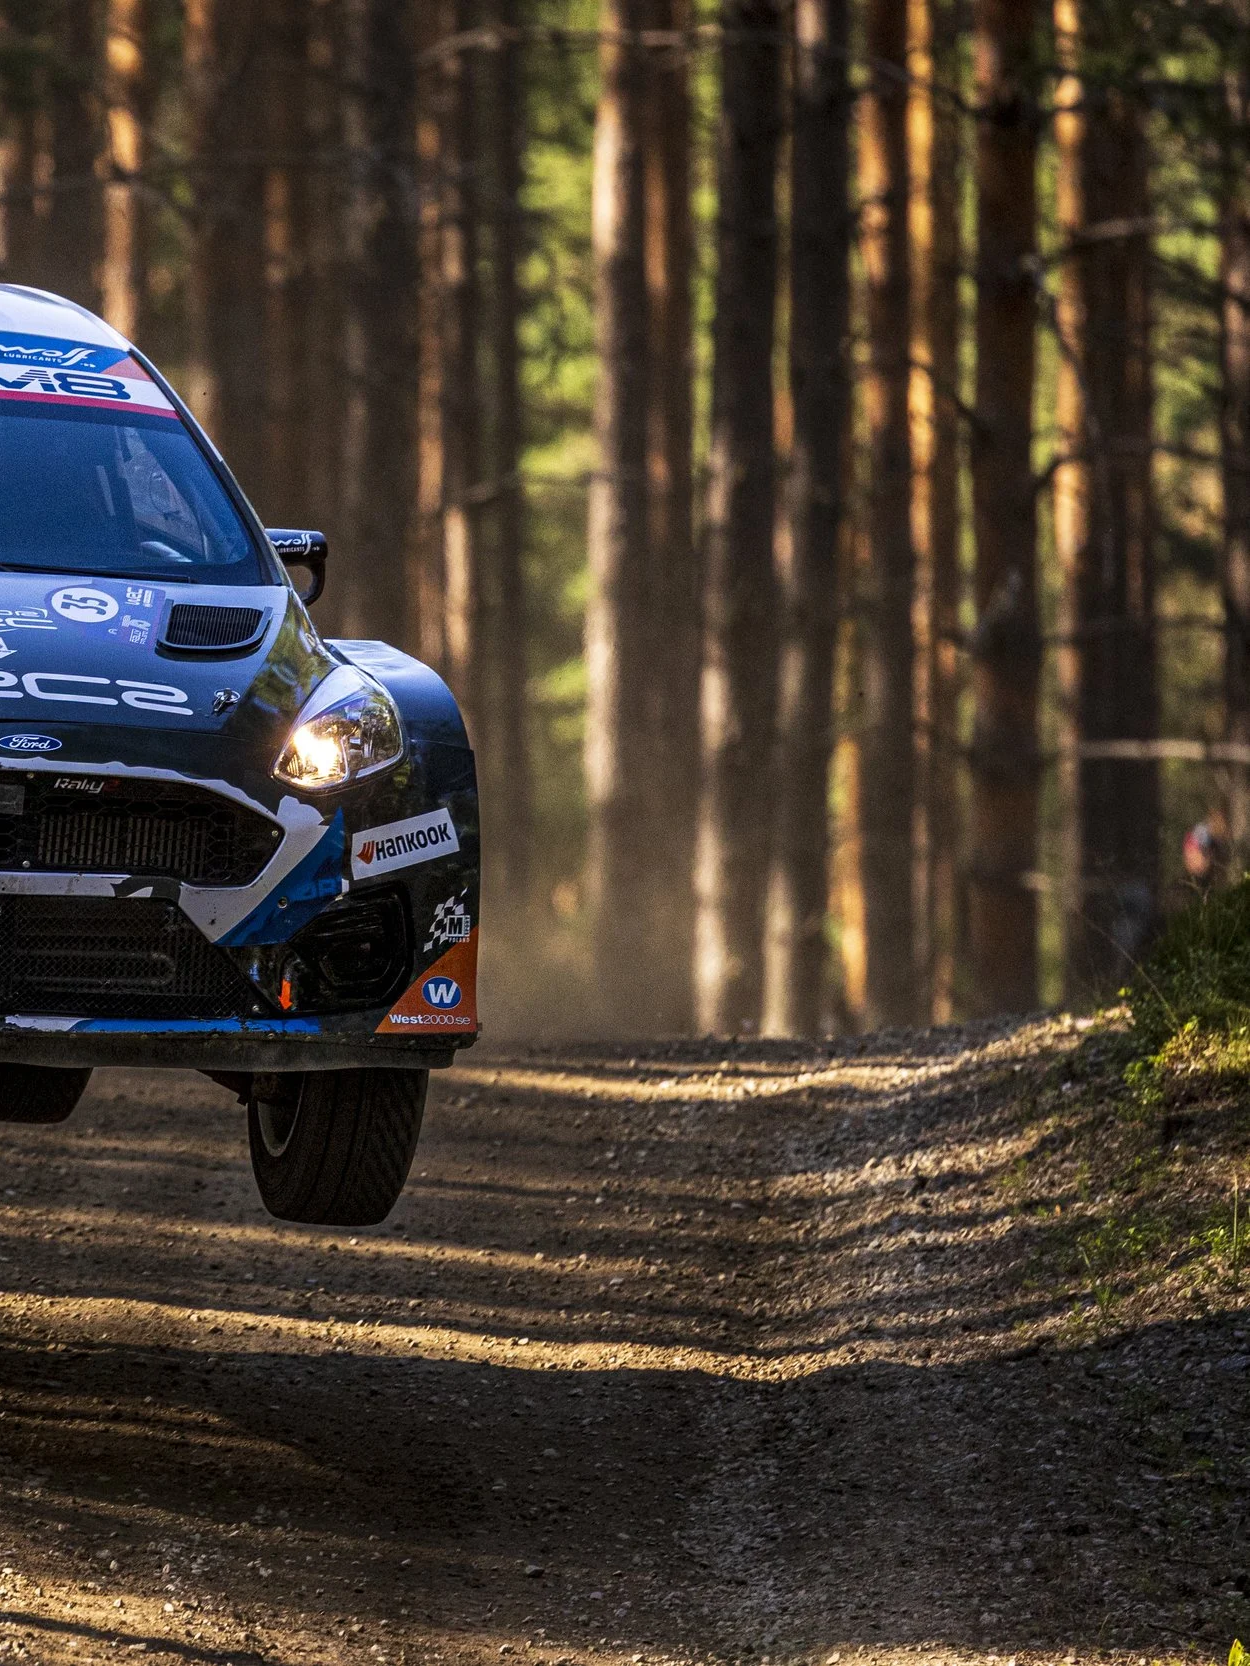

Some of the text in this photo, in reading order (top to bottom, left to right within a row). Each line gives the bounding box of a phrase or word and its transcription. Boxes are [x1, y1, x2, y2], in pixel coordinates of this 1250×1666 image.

[3, 352, 63, 364] LUBRICANTS
[8, 735, 51, 750] Ford
[428, 981, 459, 1004] W
[389, 1013, 471, 1025] West2000.se
